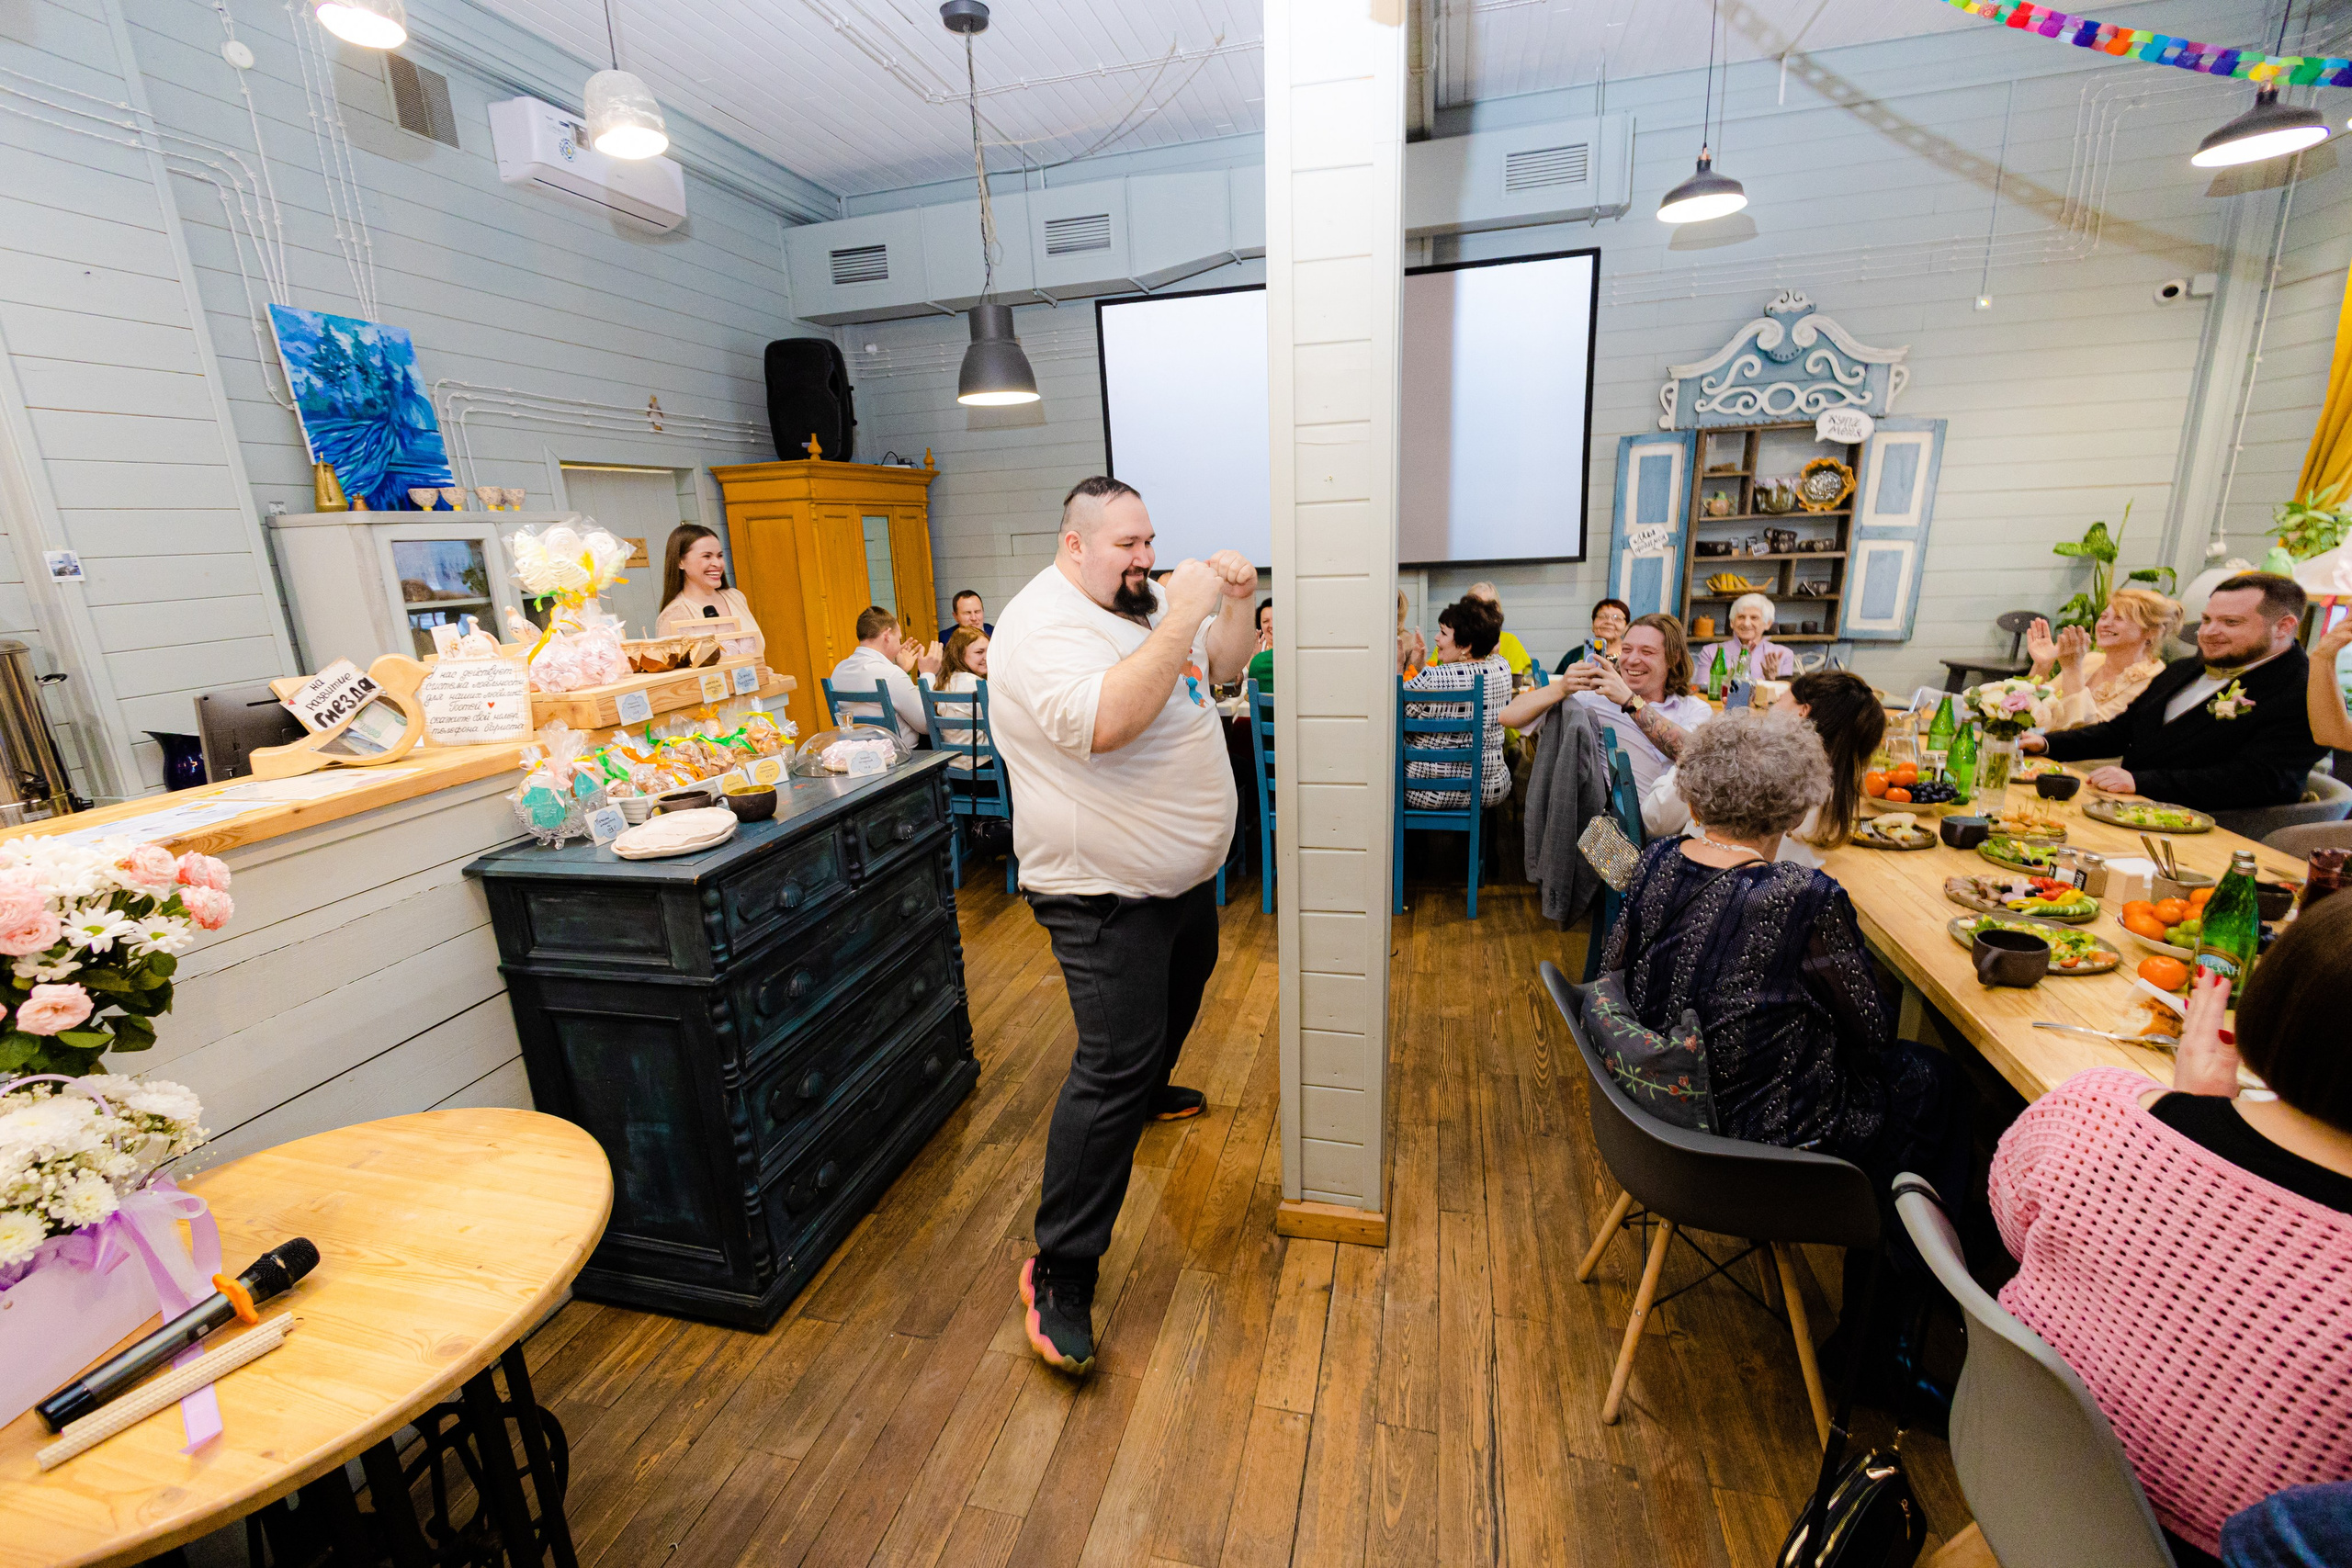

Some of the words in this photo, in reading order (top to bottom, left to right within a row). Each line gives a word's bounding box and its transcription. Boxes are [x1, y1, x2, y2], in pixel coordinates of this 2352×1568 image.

[460, 664, 512, 681] действует
[305, 672, 353, 711] развитие
[309, 678, 325, 691] на
[425, 681, 469, 690] система
[314, 677, 377, 728] Гнезда
[424, 693, 444, 707] для
[449, 700, 483, 712] Гостей
[430, 715, 471, 724] скажите
[472, 711, 491, 722] свой
[357, 722, 382, 739] 1000
[432, 726, 479, 737] телефона
[484, 722, 525, 734] бариста
